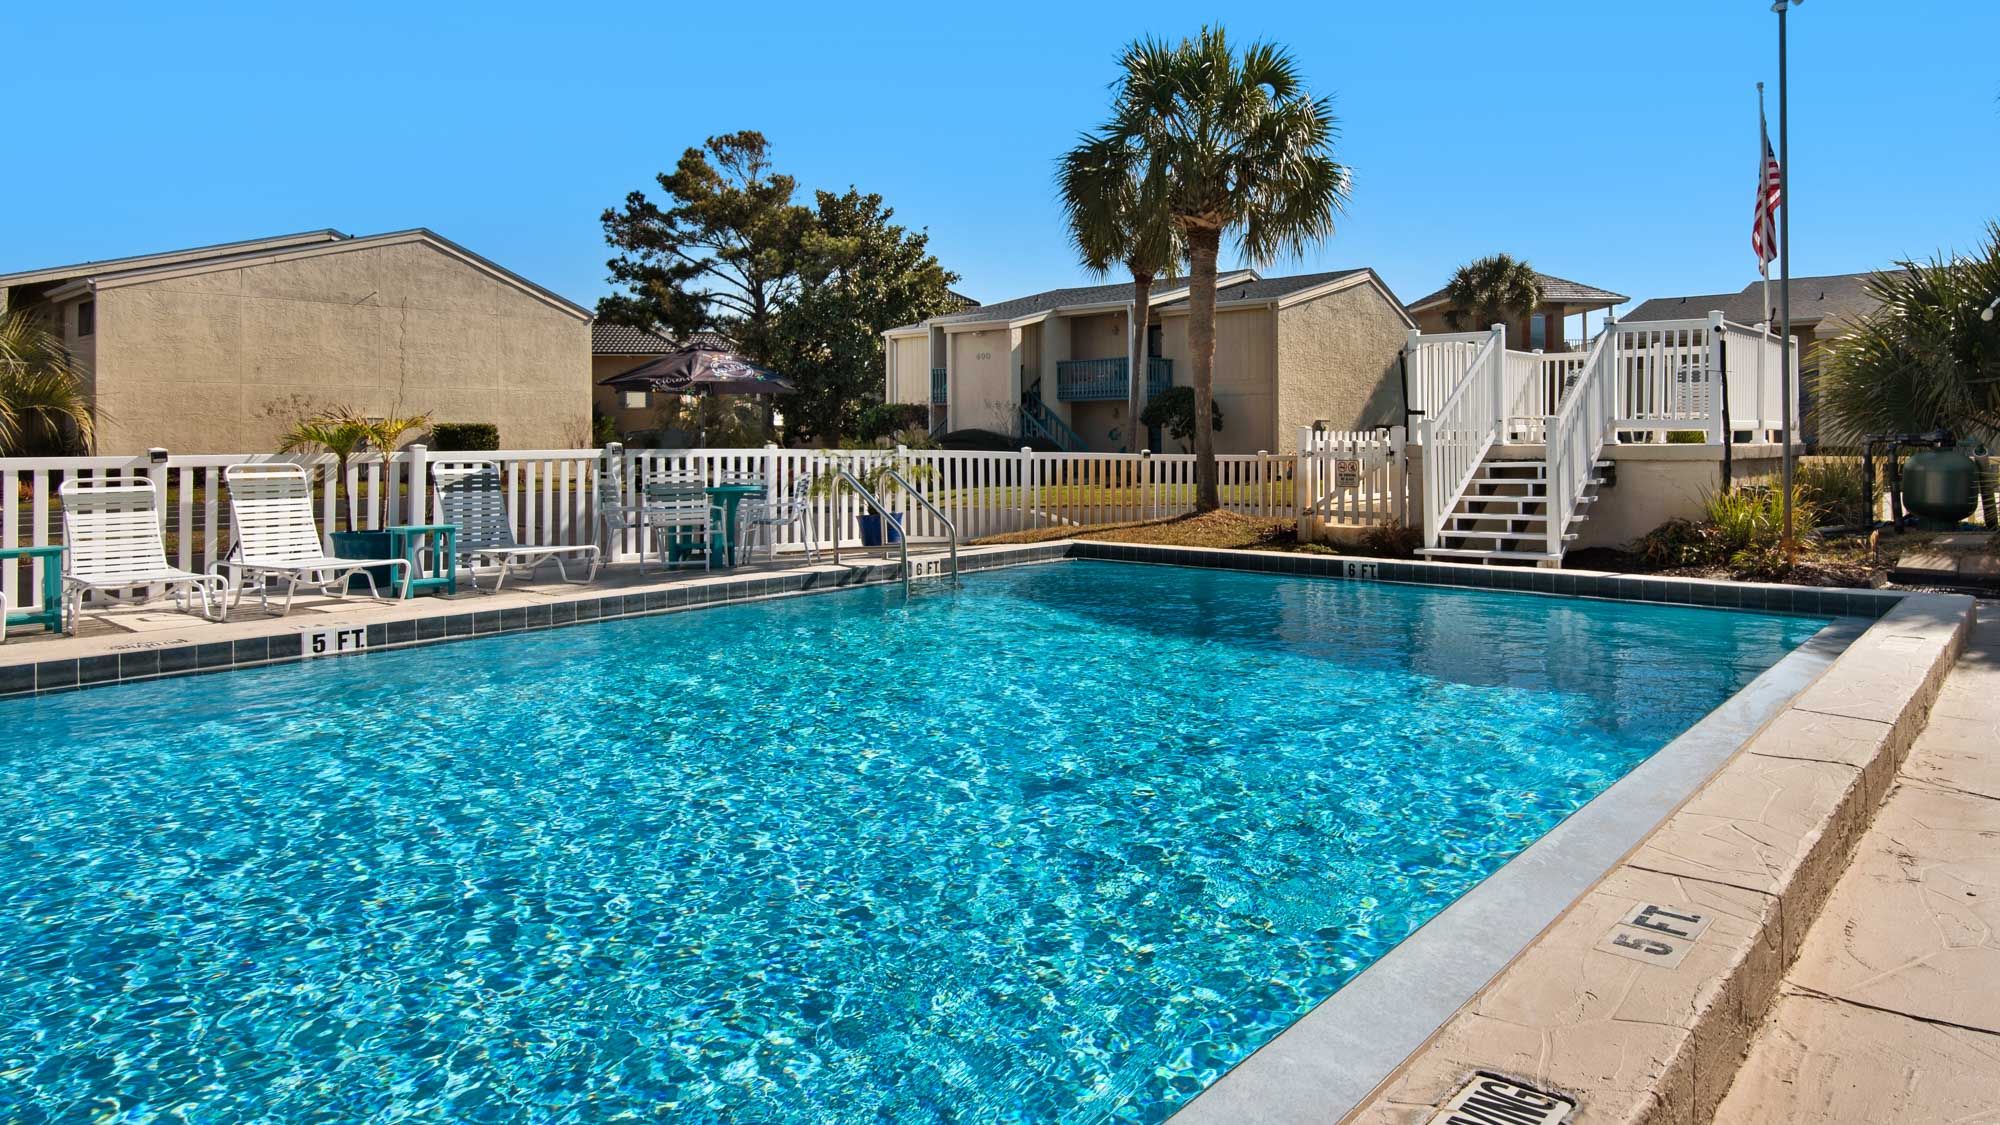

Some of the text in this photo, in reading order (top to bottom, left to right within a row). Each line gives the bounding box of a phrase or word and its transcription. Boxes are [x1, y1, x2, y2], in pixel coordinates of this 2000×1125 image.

[916, 562, 923, 576] 6
[1348, 563, 1356, 577] 6
[312, 628, 365, 653] 5 FT.
[1613, 934, 1673, 955] 5
